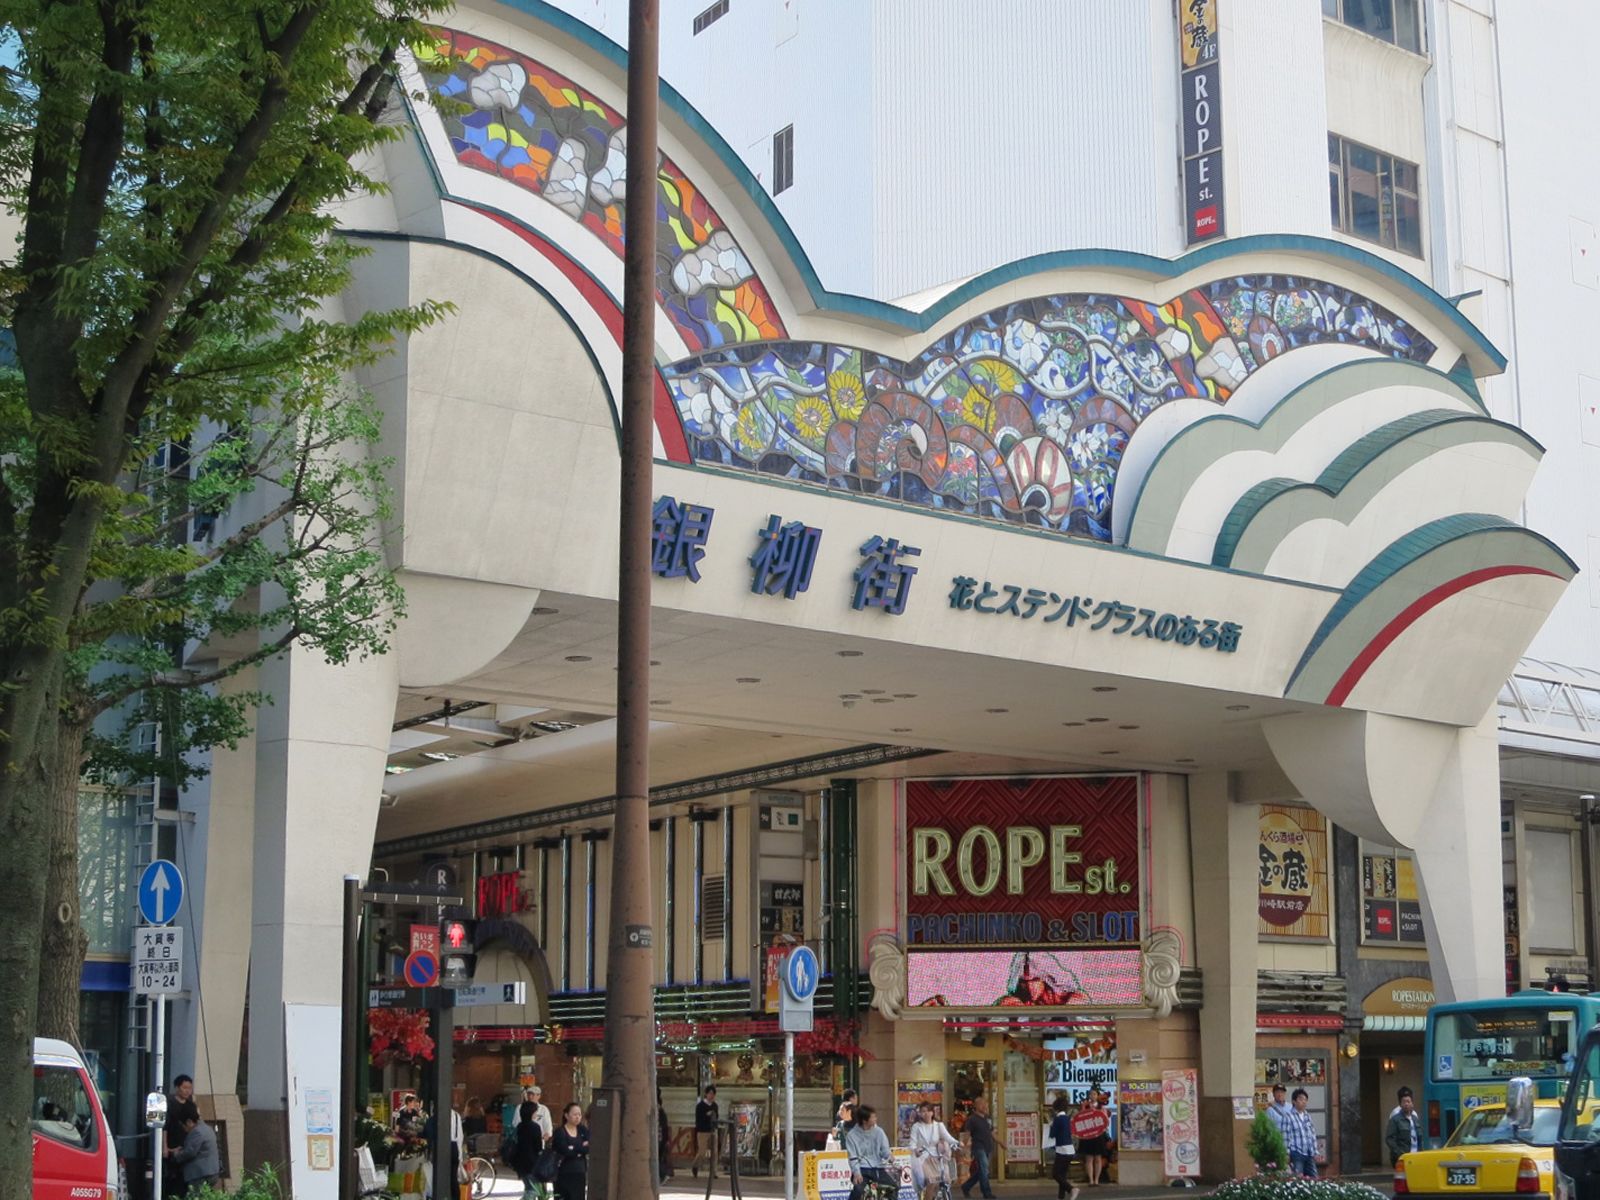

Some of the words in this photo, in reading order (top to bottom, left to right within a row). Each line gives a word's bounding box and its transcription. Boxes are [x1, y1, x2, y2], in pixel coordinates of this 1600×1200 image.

[651, 494, 922, 616] 銀柳街
[948, 575, 1243, 653] 花とステンドグラスのある街
[1259, 843, 1309, 892] 金の蔵
[907, 912, 1043, 944] PACHINKO
[1048, 920, 1069, 943] &
[1072, 911, 1139, 942] SLOT
